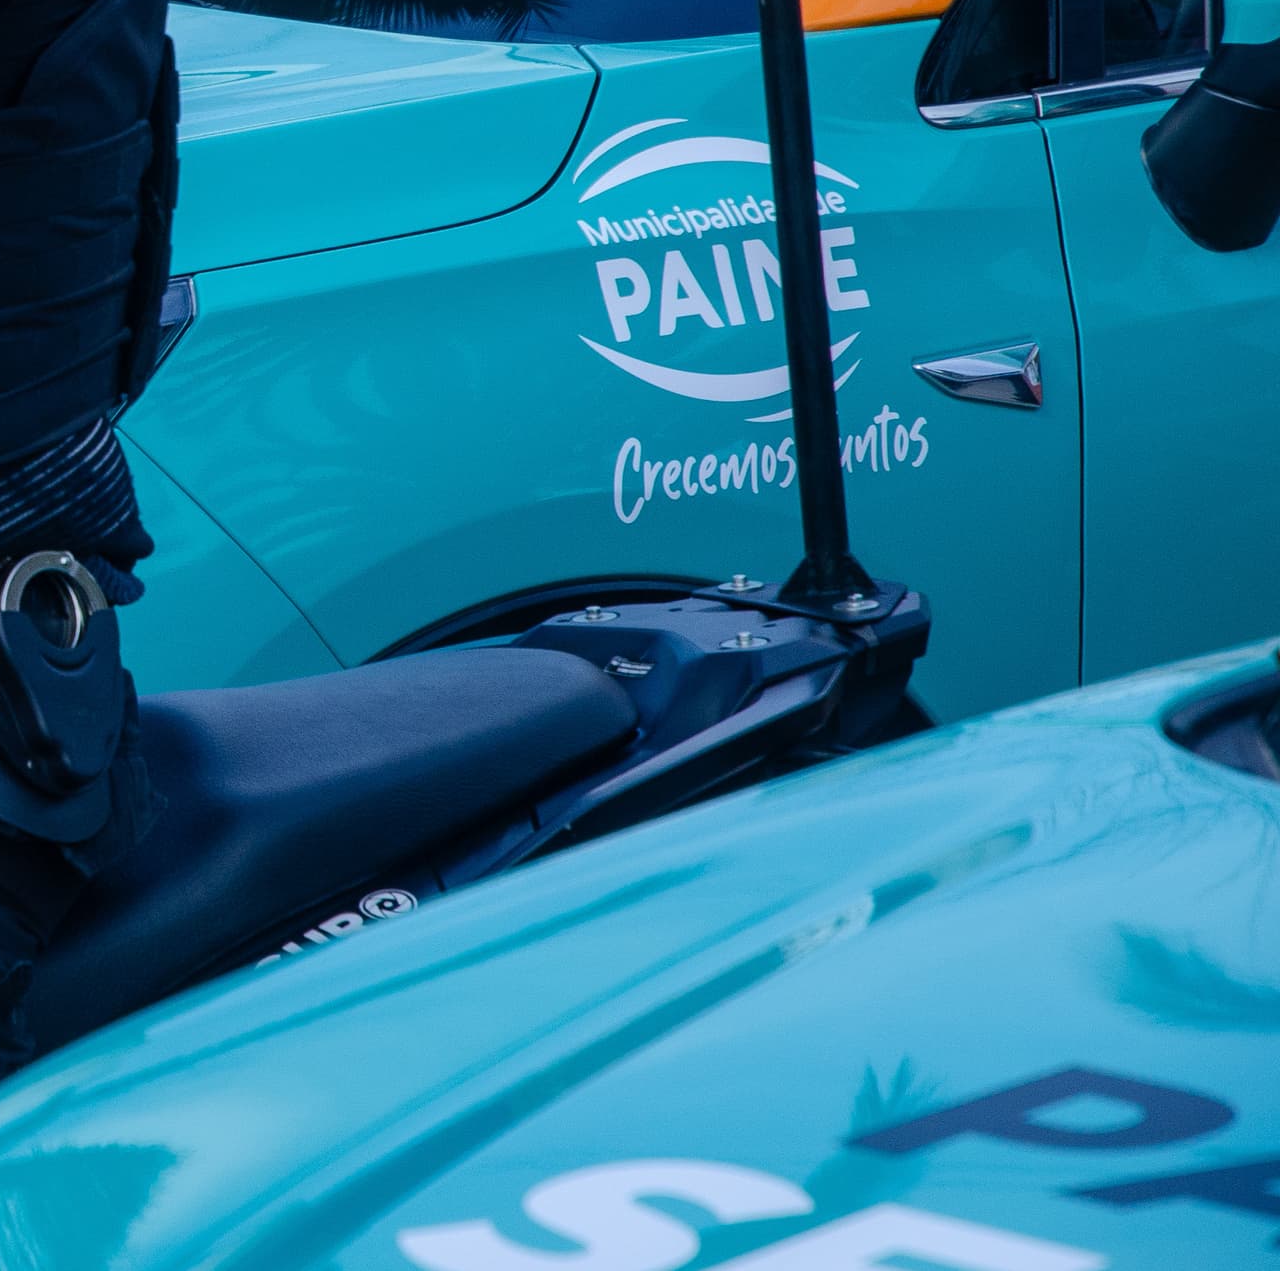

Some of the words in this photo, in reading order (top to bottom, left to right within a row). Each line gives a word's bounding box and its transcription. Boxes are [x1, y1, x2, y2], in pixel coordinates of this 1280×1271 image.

[576, 194, 777, 247] Municipalida
[595, 226, 871, 344] PAINE
[613, 436, 797, 525] Crecemos
[837, 404, 930, 474] untos
